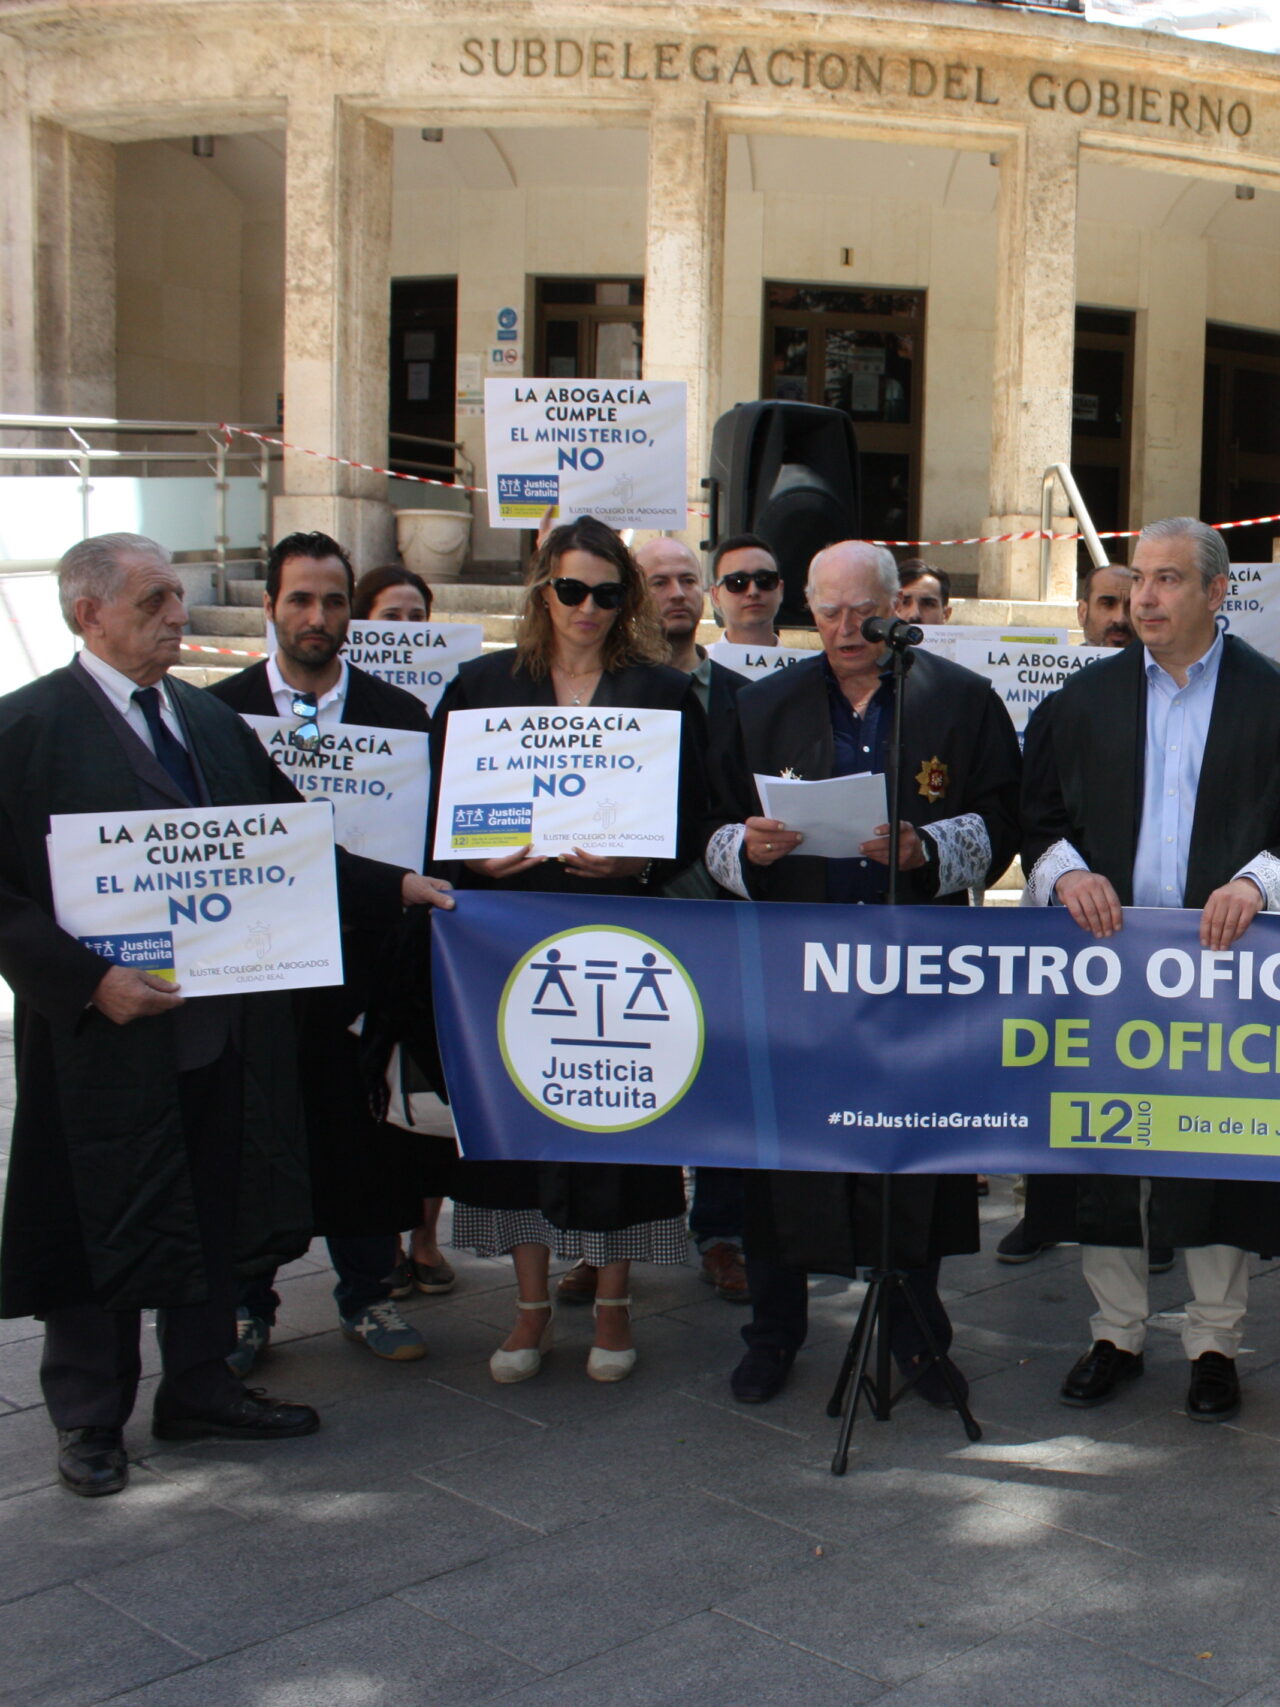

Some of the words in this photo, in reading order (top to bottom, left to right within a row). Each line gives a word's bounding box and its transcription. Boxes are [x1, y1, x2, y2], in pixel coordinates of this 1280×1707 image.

[459, 37, 884, 93] SUBDELEGACION
[908, 58, 999, 105] DEL
[1028, 72, 1252, 137] GOBIERNO
[514, 387, 538, 403] LA
[545, 386, 651, 404] ABOGACÍA
[546, 407, 617, 421] CUMPLE
[511, 427, 528, 442] EL
[535, 427, 655, 447] MINISTERIO,
[558, 447, 604, 471] NO
[524, 479, 558, 489] Justicia
[524, 488, 558, 497] Gratuita
[745, 653, 767, 668] LA
[987, 652, 1011, 666] LA
[485, 718, 512, 732] LA
[521, 714, 641, 732] ABOGACÍA
[521, 734, 603, 749] CUMPLE
[270, 750, 354, 771] CUMPLE
[476, 757, 499, 771] EL
[507, 755, 643, 773] MINISTERIO,
[533, 774, 586, 798] NO
[488, 808, 531, 817] Justicia
[488, 816, 531, 826] Gratuita
[99, 825, 134, 844] LA
[144, 814, 288, 842] ABOGACÍA
[619, 833, 664, 841] ABOGADOS
[147, 842, 245, 865] CUMPLE
[96, 875, 123, 894] EL
[134, 865, 295, 892] MINISTERIO,
[168, 893, 232, 925] NO
[120, 938, 171, 951] Justicia
[121, 950, 172, 962] Gratuita
[189, 967, 220, 977] ILUSTRE
[223, 964, 263, 975] COLEGIO
[275, 959, 329, 970] ABOGADOS
[803, 942, 1122, 996] NUESTRO
[1001, 1017, 1091, 1068] DE
[542, 1057, 654, 1083] Justicia
[542, 1083, 657, 1109] Gratuita
[828, 1110, 1029, 1129] #DíaJusticiaGratuita
[1069, 1099, 1134, 1144] 12
[1137, 1101, 1151, 1147] JULIO
[1178, 1114, 1211, 1134] Día
[1218, 1117, 1243, 1134] de
[1250, 1118, 1268, 1136] la
